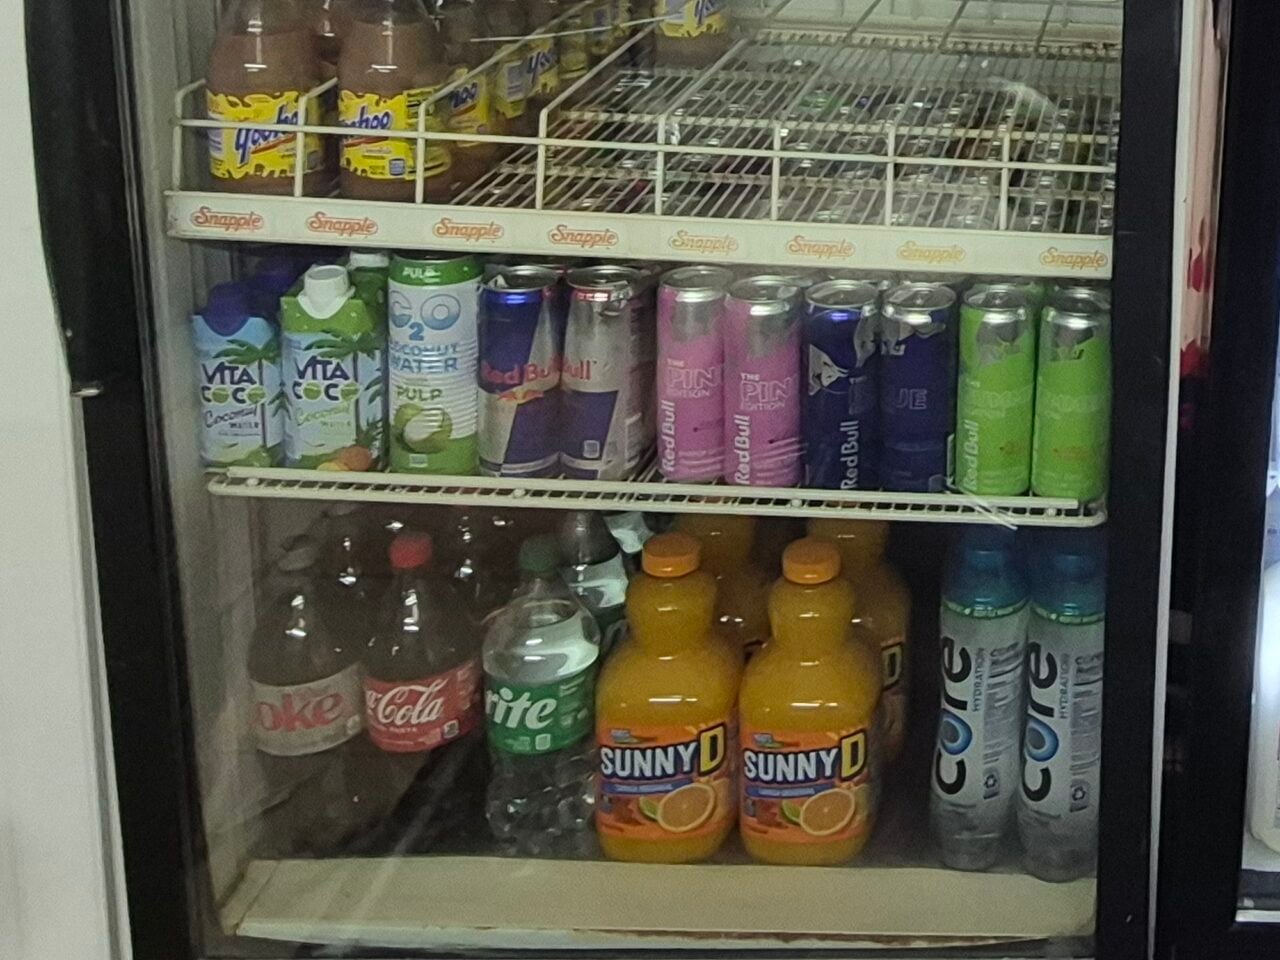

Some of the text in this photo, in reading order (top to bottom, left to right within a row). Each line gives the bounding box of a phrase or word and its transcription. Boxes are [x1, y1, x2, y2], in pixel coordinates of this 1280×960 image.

[193, 206, 264, 231] Snapple
[307, 211, 378, 237] Snapple
[435, 218, 502, 244] Snapple
[551, 224, 619, 248] Snapple
[790, 235, 855, 259] Snapple
[1041, 247, 1108, 270] Snapple
[201, 361, 258, 386] VITA
[294, 355, 351, 381] VITA
[201, 384, 267, 404] COCO
[292, 380, 360, 402] COCO
[661, 400, 676, 472] Red Bull
[733, 414, 750, 485] Red Bull
[840, 420, 859, 490] Red Bull
